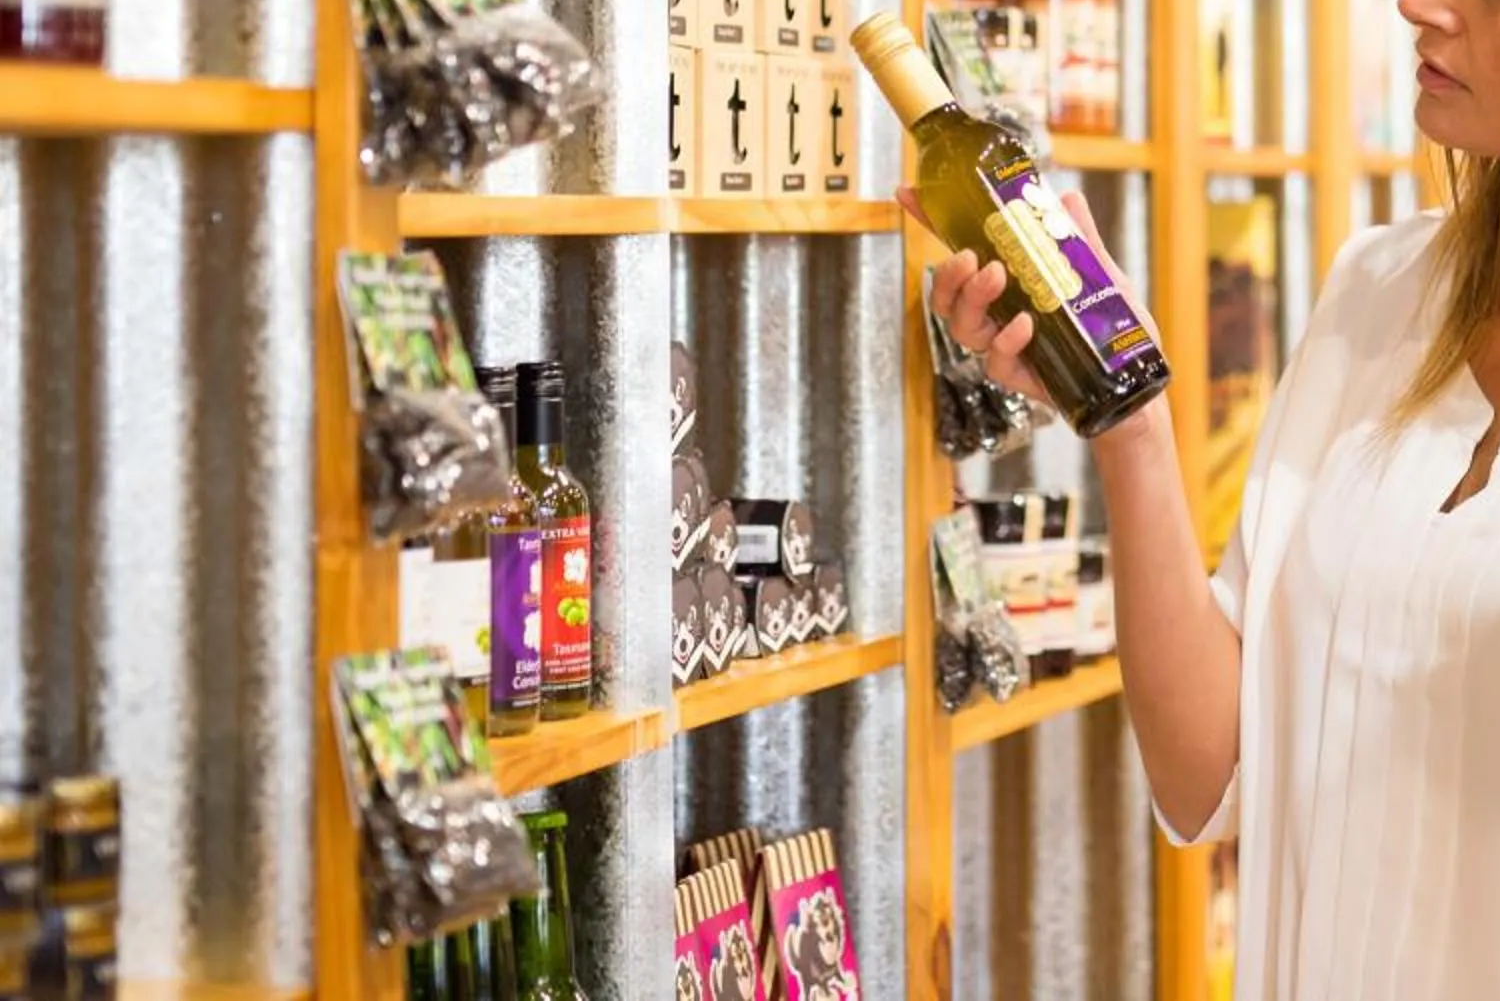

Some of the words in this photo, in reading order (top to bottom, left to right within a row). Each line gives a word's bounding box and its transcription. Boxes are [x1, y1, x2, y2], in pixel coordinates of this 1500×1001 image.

[727, 78, 748, 165] t
[787, 83, 800, 166] t
[829, 88, 844, 168] t
[541, 527, 576, 540] EXTRA
